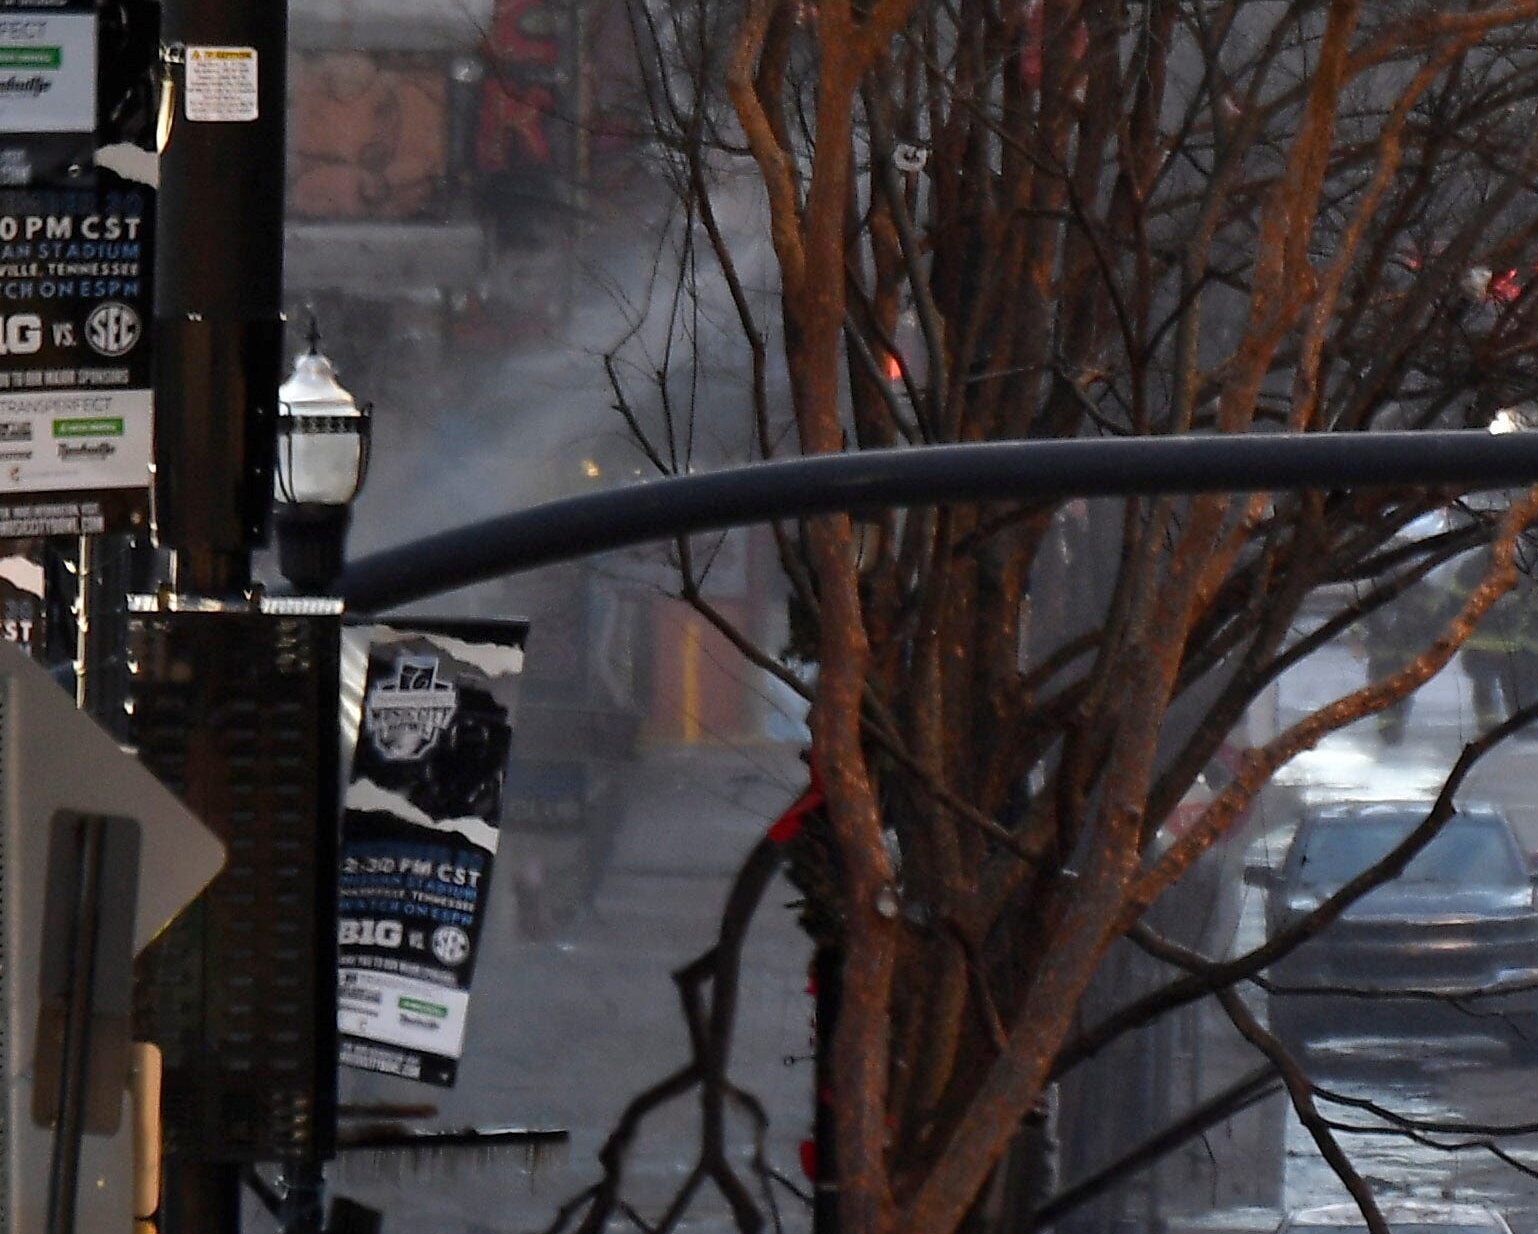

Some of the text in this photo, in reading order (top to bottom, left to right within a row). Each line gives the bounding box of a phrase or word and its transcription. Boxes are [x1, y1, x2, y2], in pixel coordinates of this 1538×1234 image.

[25, 216, 73, 240] PM
[81, 216, 141, 240] CST
[38, 243, 140, 259] STADIUM
[48, 263, 138, 276] TENNESSEE
[39, 282, 74, 298] ON
[79, 280, 139, 297] ESPN
[88, 304, 138, 354] SEC
[436, 863, 481, 888] CST
